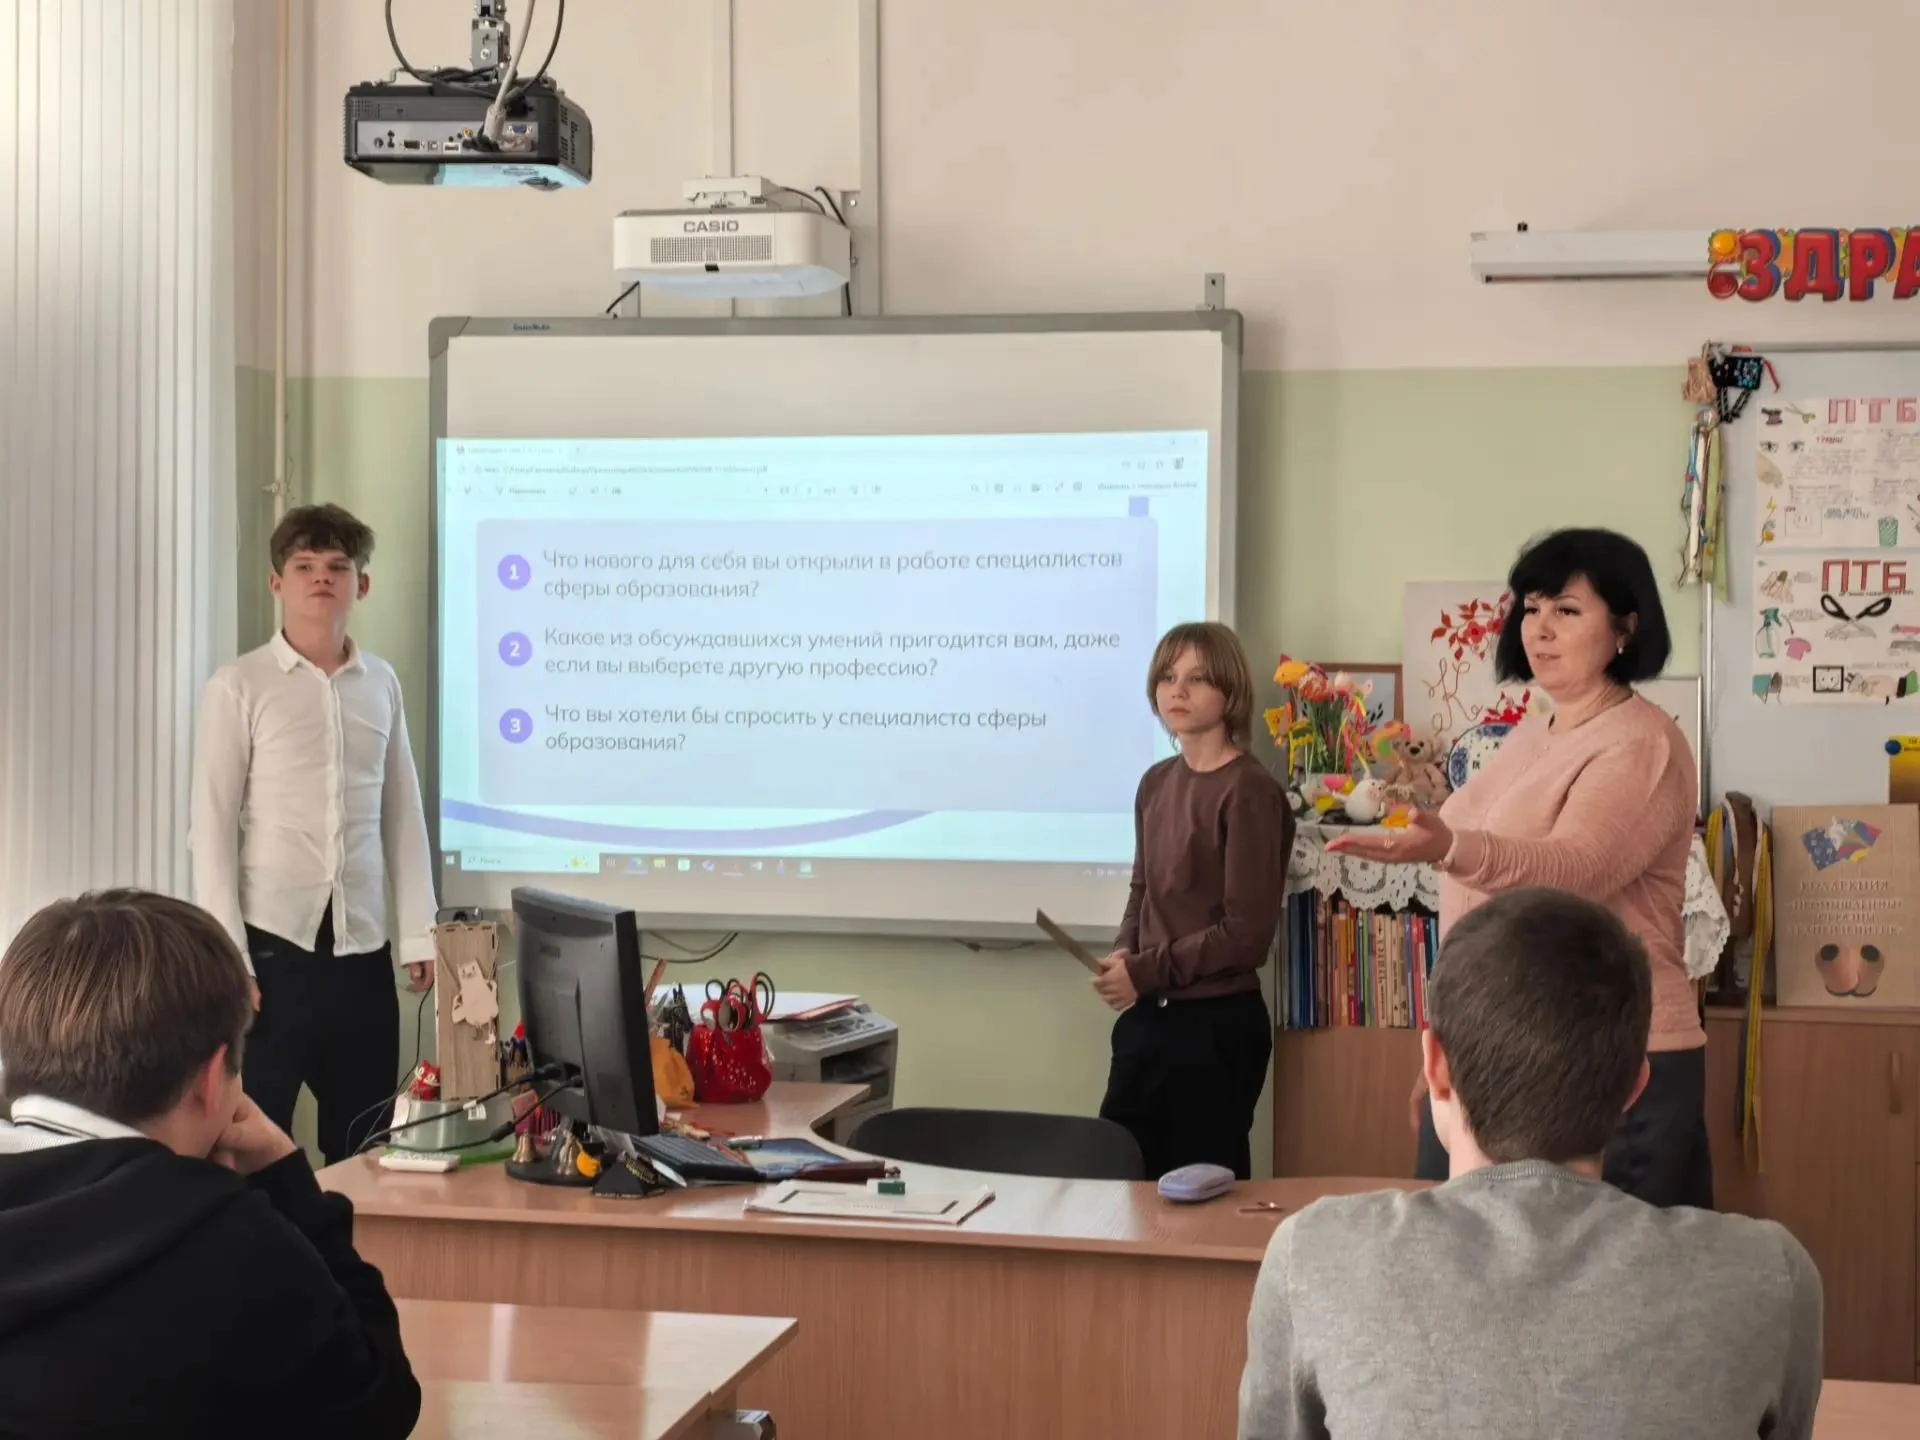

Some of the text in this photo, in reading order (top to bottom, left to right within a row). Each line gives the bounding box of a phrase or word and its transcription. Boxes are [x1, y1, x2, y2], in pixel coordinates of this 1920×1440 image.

[683, 220, 739, 232] CASIO
[1828, 398, 1917, 424] ПТБ
[508, 564, 520, 580] 1
[543, 549, 1123, 575] Что нового для себя вы открыли в работе специалистов
[1821, 559, 1907, 593] ПТБ
[543, 577, 760, 602] сферы образования?
[509, 641, 521, 658] 2
[544, 627, 1121, 653] Какое из обсуждавшихся умений пригодится вам, даже
[544, 655, 938, 681] если вы выберете другую профессию?
[510, 717, 521, 734] 3
[545, 703, 1047, 731] Что вы хотели бы спросить у специалиста сферы
[545, 731, 687, 754] образования?
